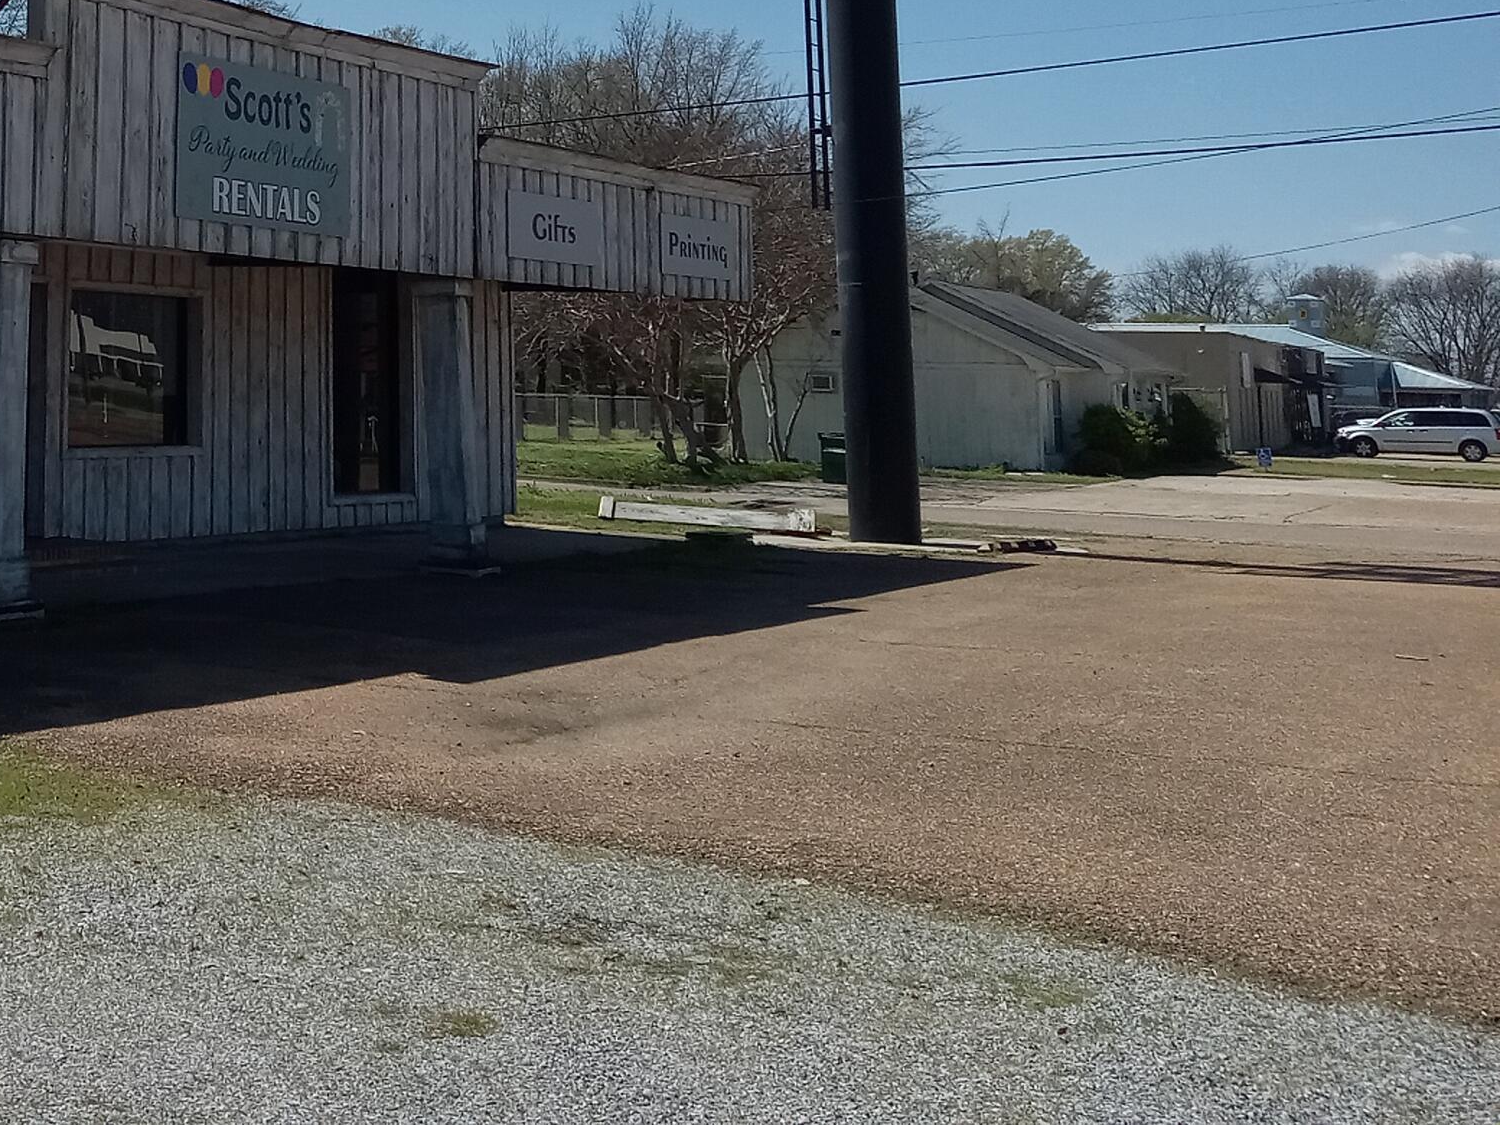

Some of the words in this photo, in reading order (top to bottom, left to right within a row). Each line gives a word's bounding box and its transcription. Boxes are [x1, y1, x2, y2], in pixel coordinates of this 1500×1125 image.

[224, 76, 312, 135] Scott's
[188, 125, 237, 172] Party
[238, 139, 271, 164] and
[272, 141, 339, 189] Wedding
[211, 175, 322, 226] RENTALS
